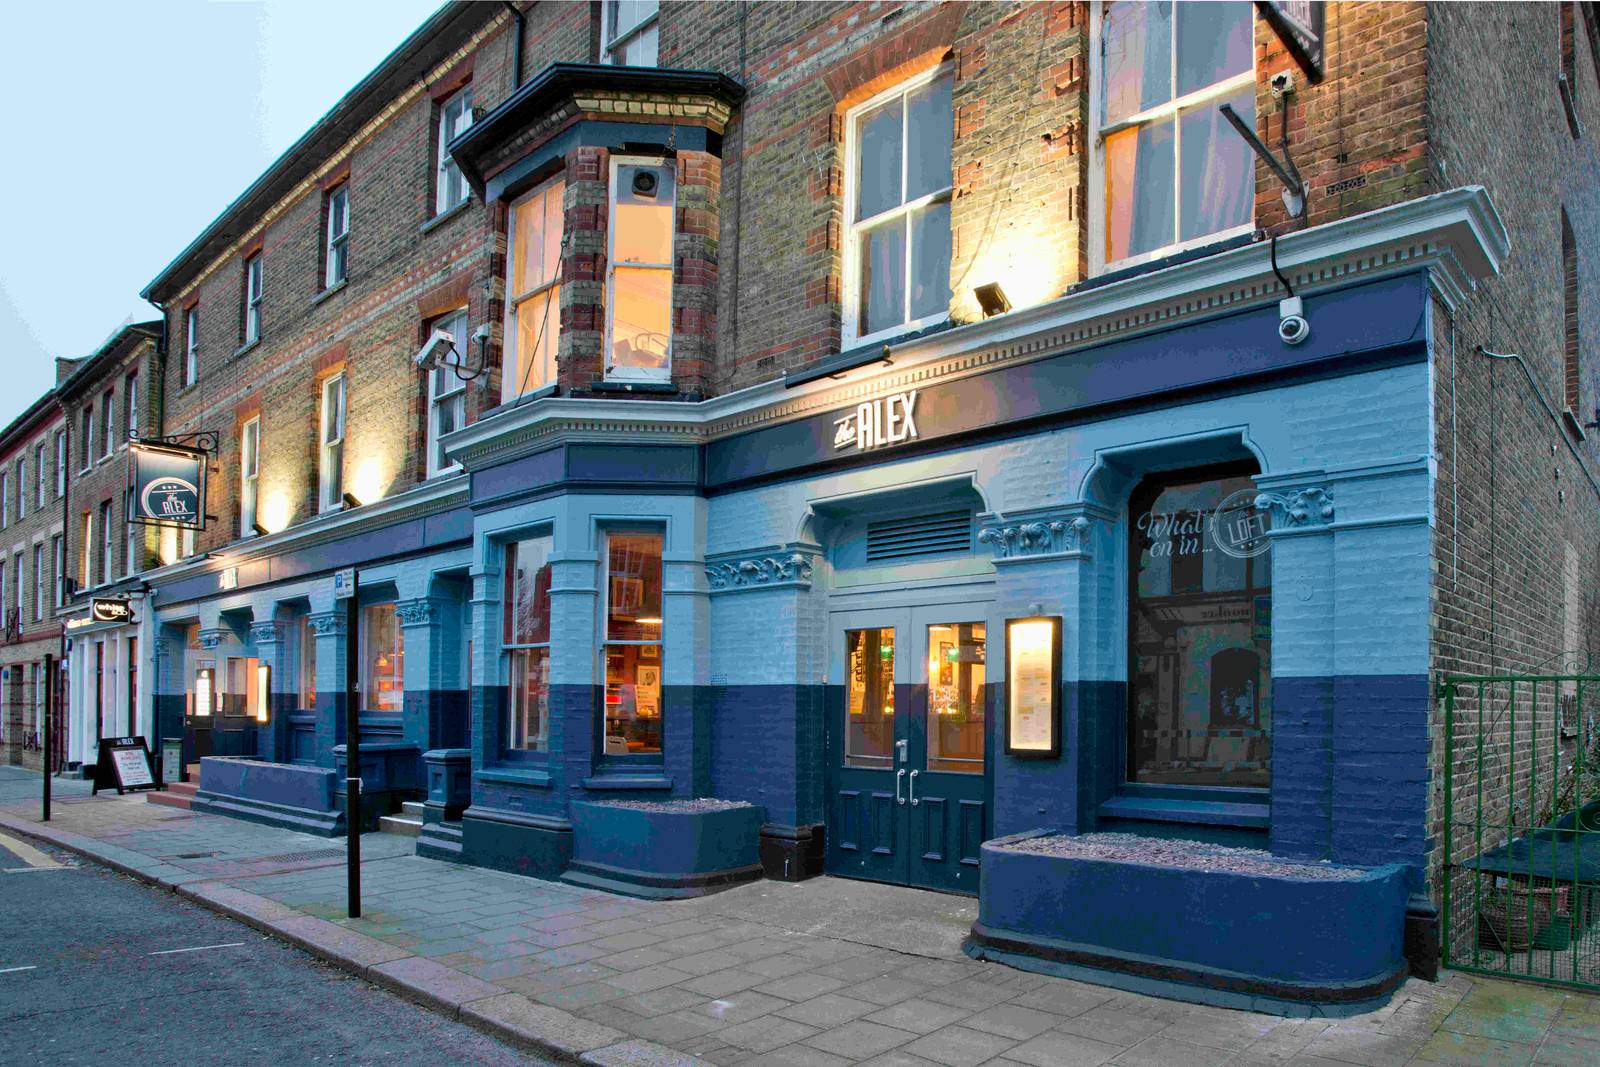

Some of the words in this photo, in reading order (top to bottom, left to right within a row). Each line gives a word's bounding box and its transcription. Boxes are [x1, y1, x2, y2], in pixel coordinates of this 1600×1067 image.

[833, 415, 857, 448] the
[857, 390, 918, 449] ALEX
[162, 500, 188, 514] ALEX
[1228, 513, 1264, 544] LOFT
[1150, 540, 1174, 557] on
